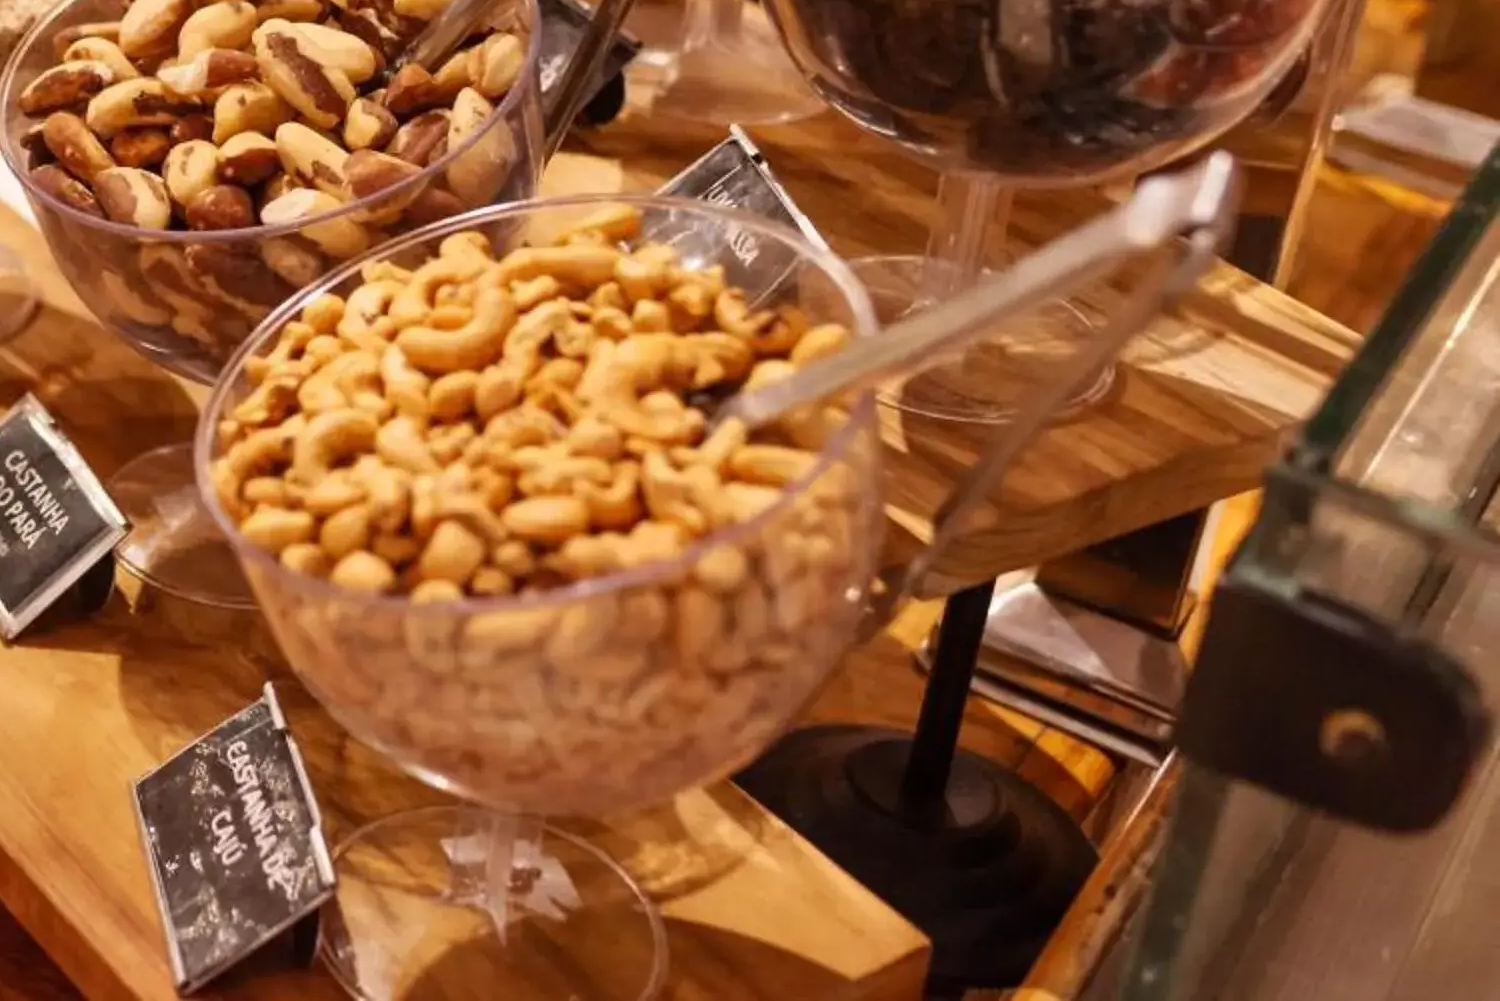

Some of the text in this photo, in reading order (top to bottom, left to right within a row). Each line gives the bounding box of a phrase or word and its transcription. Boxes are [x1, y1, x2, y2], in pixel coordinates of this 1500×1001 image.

[5, 451, 69, 535] CASTANHA
[5, 501, 47, 549] PARÁ
[226, 740, 278, 858] CASTANHA
